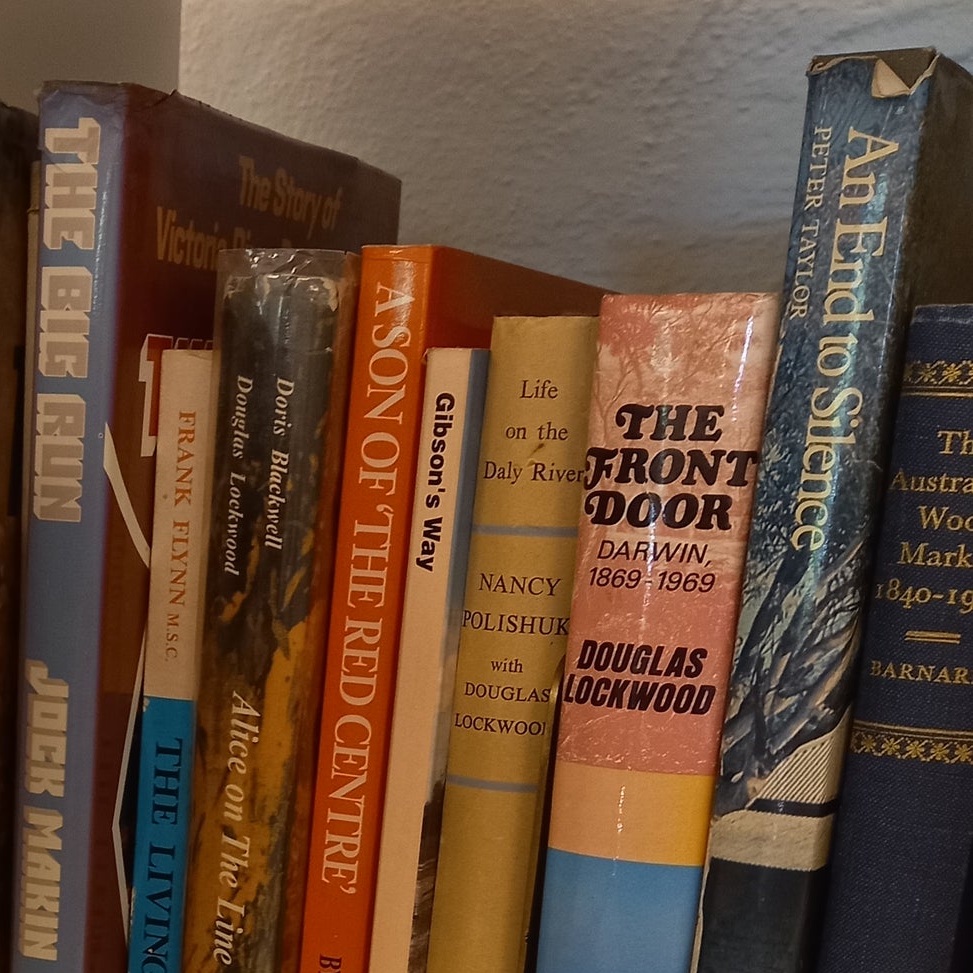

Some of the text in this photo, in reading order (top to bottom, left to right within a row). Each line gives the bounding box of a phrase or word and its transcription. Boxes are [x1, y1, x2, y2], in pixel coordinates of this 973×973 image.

[238, 155, 271, 212] The
[273, 167, 322, 240] Story
[321, 186, 343, 231] of
[789, 126, 832, 320] PETER TAYLOR
[33, 117, 101, 522] THE BIG RUN
[374, 281, 415, 317] A
[790, 126, 900, 551] An End to Silence
[364, 325, 411, 425] SON
[520, 379, 559, 400] Life
[505, 421, 568, 440] on the
[616, 403, 725, 442] THE
[174, 411, 196, 506] FRANK
[223, 375, 254, 576] Douglas Lockwood
[264, 375, 295, 550] Doris Blackwell
[358, 432, 400, 496] OF
[416, 392, 455, 572] Gibson's Way
[484, 461, 584, 483] Daly River
[584, 447, 758, 490] FRONT
[584, 490, 732, 531] DOOR
[169, 520, 190, 607] FLYNN
[597, 540, 712, 568] DARWIN,
[479, 573, 561, 596] NANCY
[462, 609, 569, 636] POLISHUK
[339, 616, 383, 706] RED
[490, 658, 524, 673] with
[577, 639, 707, 678] DOUGLAS
[870, 660, 973, 685] BARNAR
[465, 682, 551, 703] DOUGLAS
[564, 672, 716, 715] LOCKWOOD
[152, 738, 183, 825] THE
[18, 658, 69, 961] JOCK MAKIN
[213, 690, 261, 966] Alice on The Line
